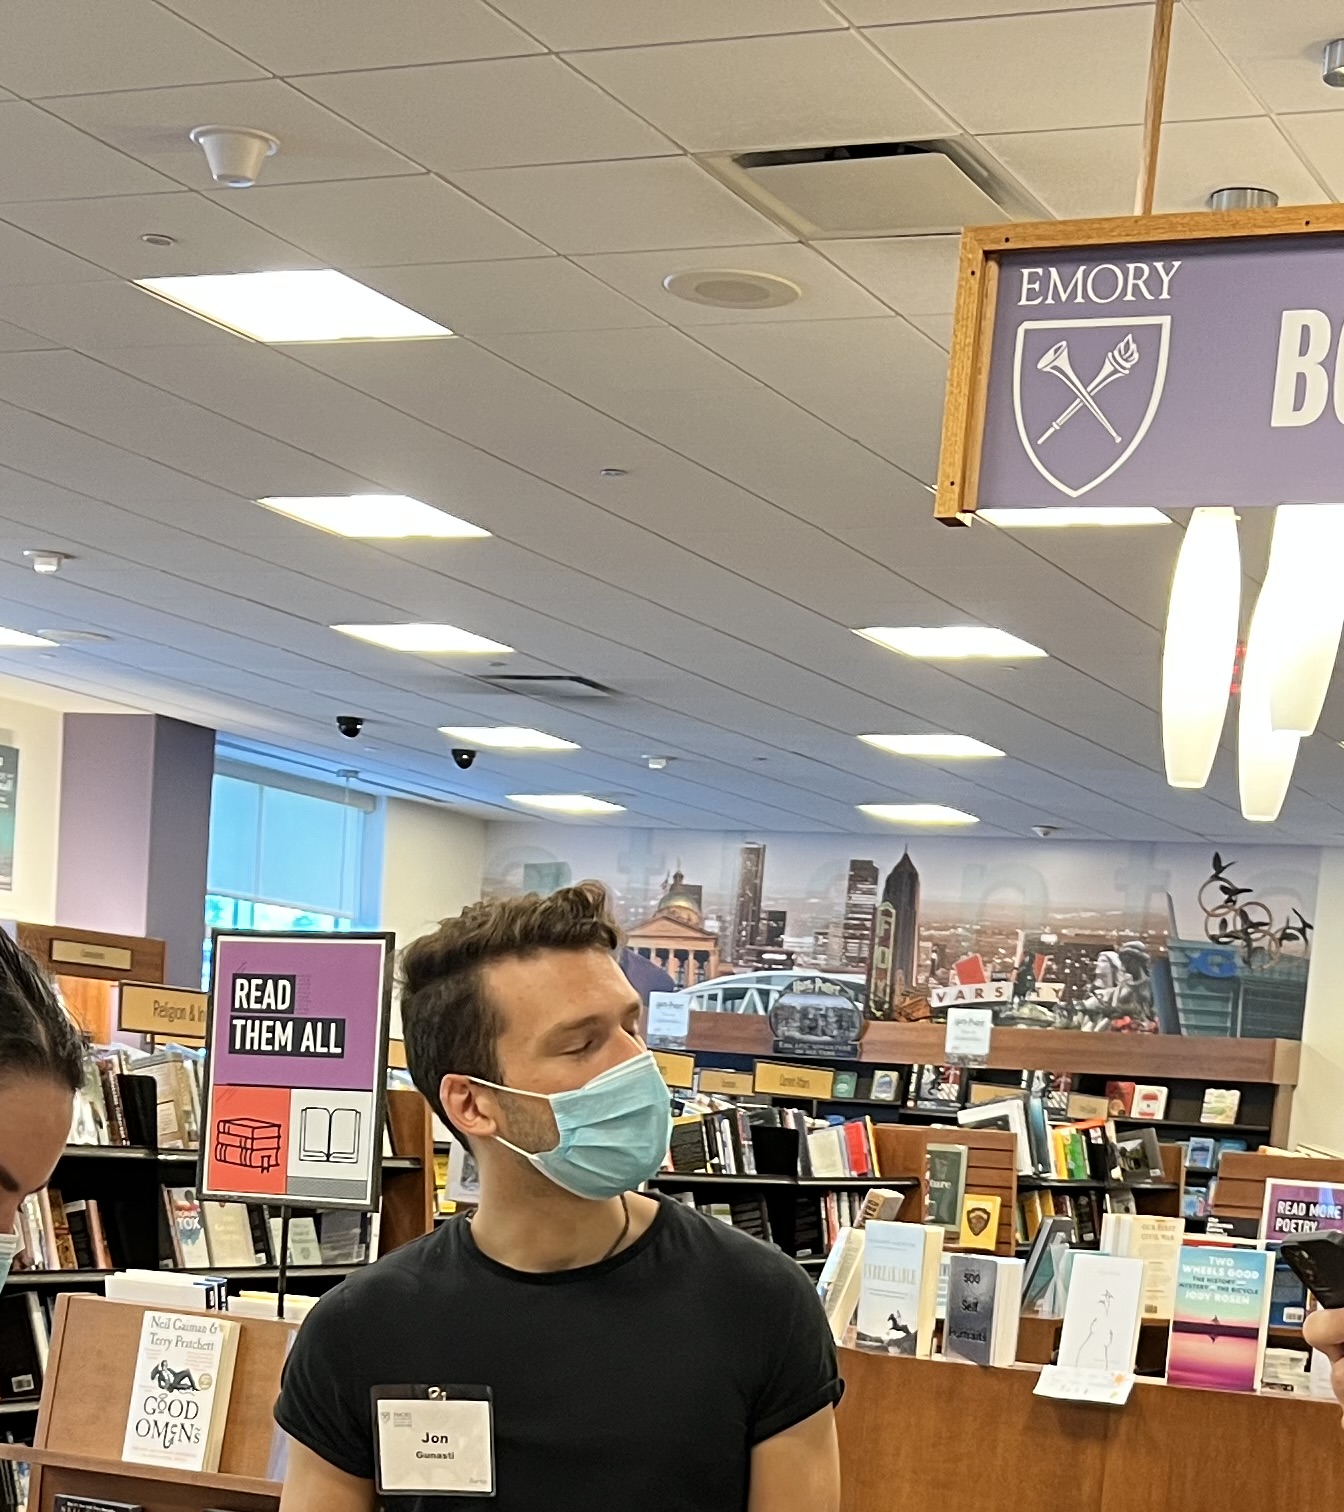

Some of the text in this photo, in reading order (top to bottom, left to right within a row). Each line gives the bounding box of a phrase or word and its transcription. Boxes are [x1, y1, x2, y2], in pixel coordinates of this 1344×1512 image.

[1017, 260, 1182, 309] EMORY
[234, 977, 292, 1011] READ
[153, 999, 197, 1023] Religion &
[232, 1019, 343, 1054] THEM ALL
[1276, 1200, 1343, 1219] READ MORE
[1274, 1217, 1318, 1233] POETRY
[1208, 1256, 1235, 1267] TWO
[962, 1273, 981, 1284] 500
[1182, 1264, 1260, 1280] WHEELS GOOD
[150, 1315, 170, 1330] Neil
[172, 1318, 207, 1334] Gaiman
[149, 1331, 215, 1352] Terry Pratchett
[421, 1431, 449, 1444] Jon
